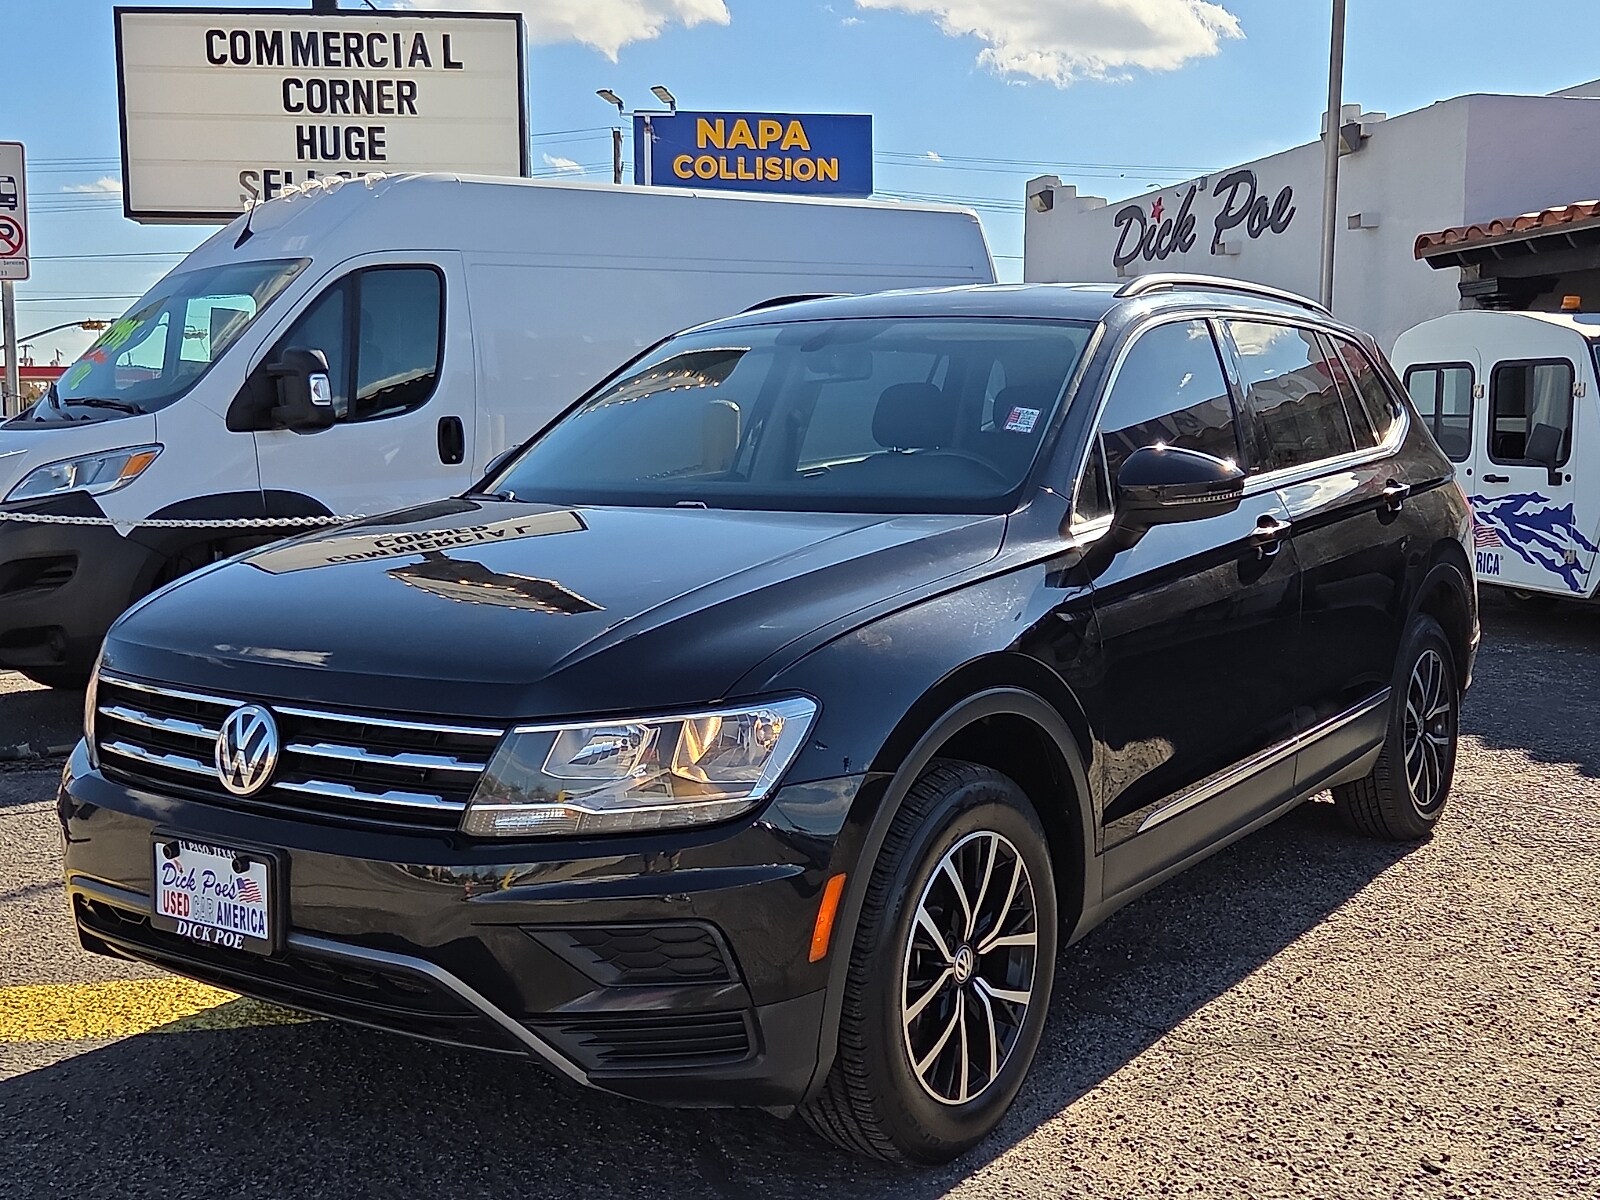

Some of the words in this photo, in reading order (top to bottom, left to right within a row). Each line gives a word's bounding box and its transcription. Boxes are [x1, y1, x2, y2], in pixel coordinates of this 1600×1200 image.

[205, 29, 463, 69] COMMERCIAL
[282, 77, 418, 115] CORNER
[296, 125, 387, 161] HUGE
[696, 118, 811, 151] NAPA
[672, 154, 839, 182] COLLISION
[1112, 184, 1197, 268] Dick
[1210, 169, 1297, 256] Poe
[1475, 551, 1500, 575] RICA
[212, 846, 237, 860] TEXAS
[162, 862, 196, 891] Dick
[201, 869, 237, 900] Poe's
[163, 890, 190, 917] USED
[216, 901, 266, 935] AMERICA
[176, 920, 212, 943] DICK
[214, 928, 245, 950] POE
